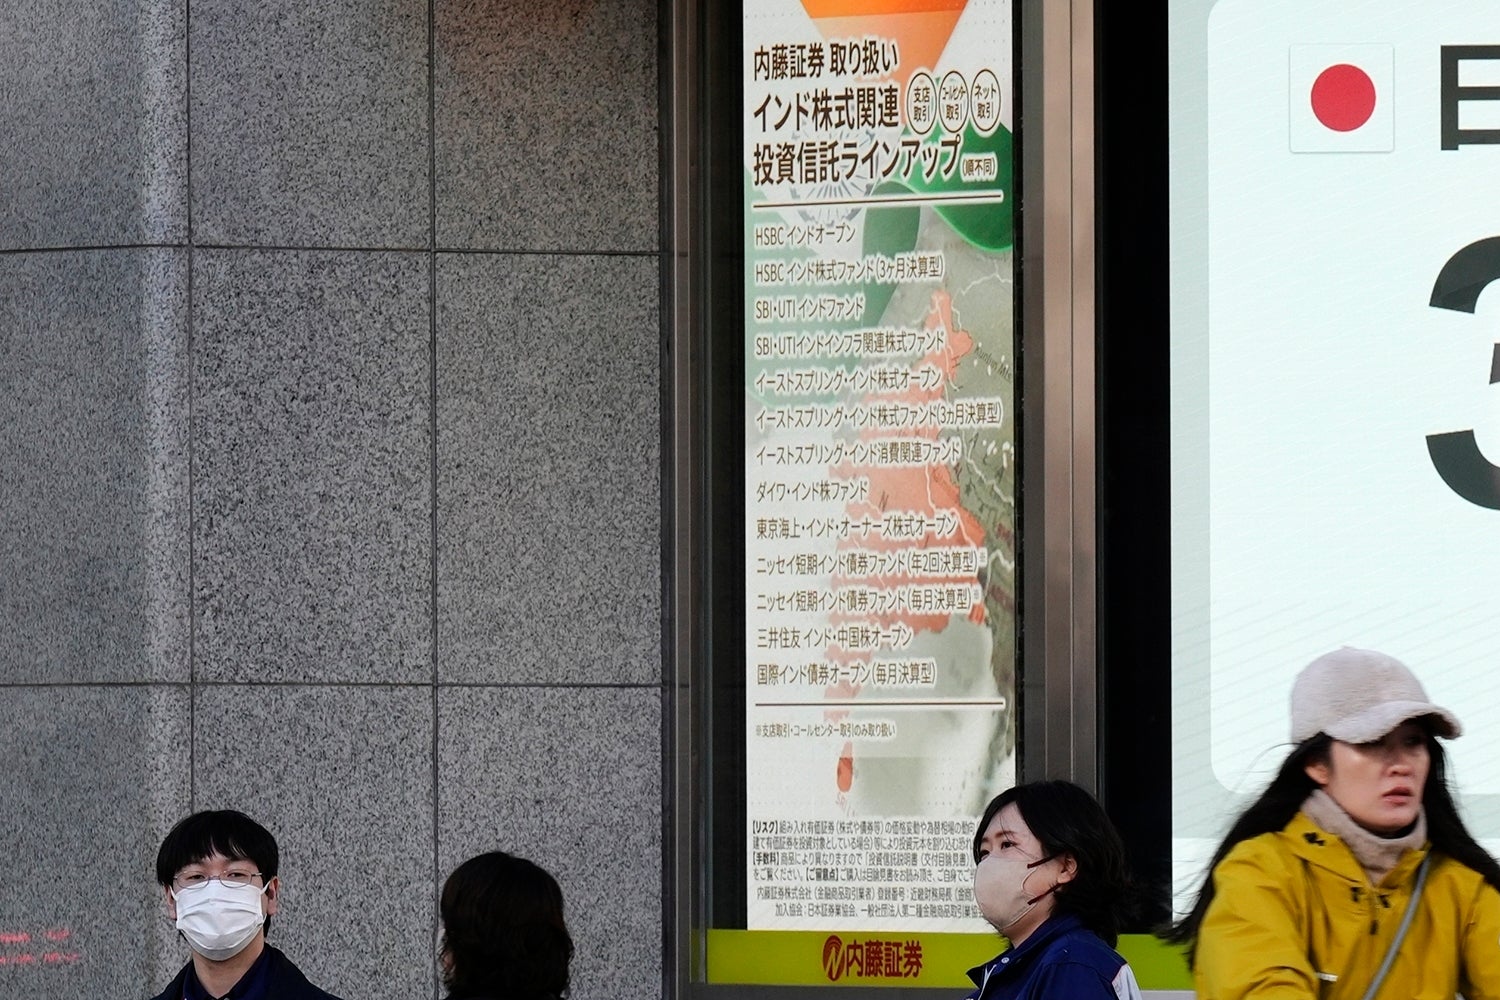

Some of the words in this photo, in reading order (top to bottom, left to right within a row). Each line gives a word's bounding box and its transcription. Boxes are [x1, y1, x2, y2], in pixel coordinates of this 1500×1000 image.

[753, 43, 825, 81] 内藤証券
[829, 39, 899, 78] 取り扱い
[913, 87, 931, 104] 支店
[974, 83, 997, 99] ネット
[753, 85, 899, 133] インド株式関連
[913, 105, 931, 122] 取引
[945, 103, 963, 120] 取引
[978, 102, 995, 118] 取引
[753, 134, 962, 186] 投資信託ラインアップ
[755, 226, 784, 247] HSBC
[787, 223, 856, 246] インドオープン
[755, 263, 784, 283] HSBC
[798, 297, 865, 320] インドファンド
[755, 368, 942, 394] イーストスプリング・インド株式オープン
[756, 480, 868, 503] ダイワ・インド株ファンド
[757, 628, 801, 650] 三井住友
[803, 625, 912, 649] インド・中国株オープン
[846, 939, 923, 979] 内藤証券
